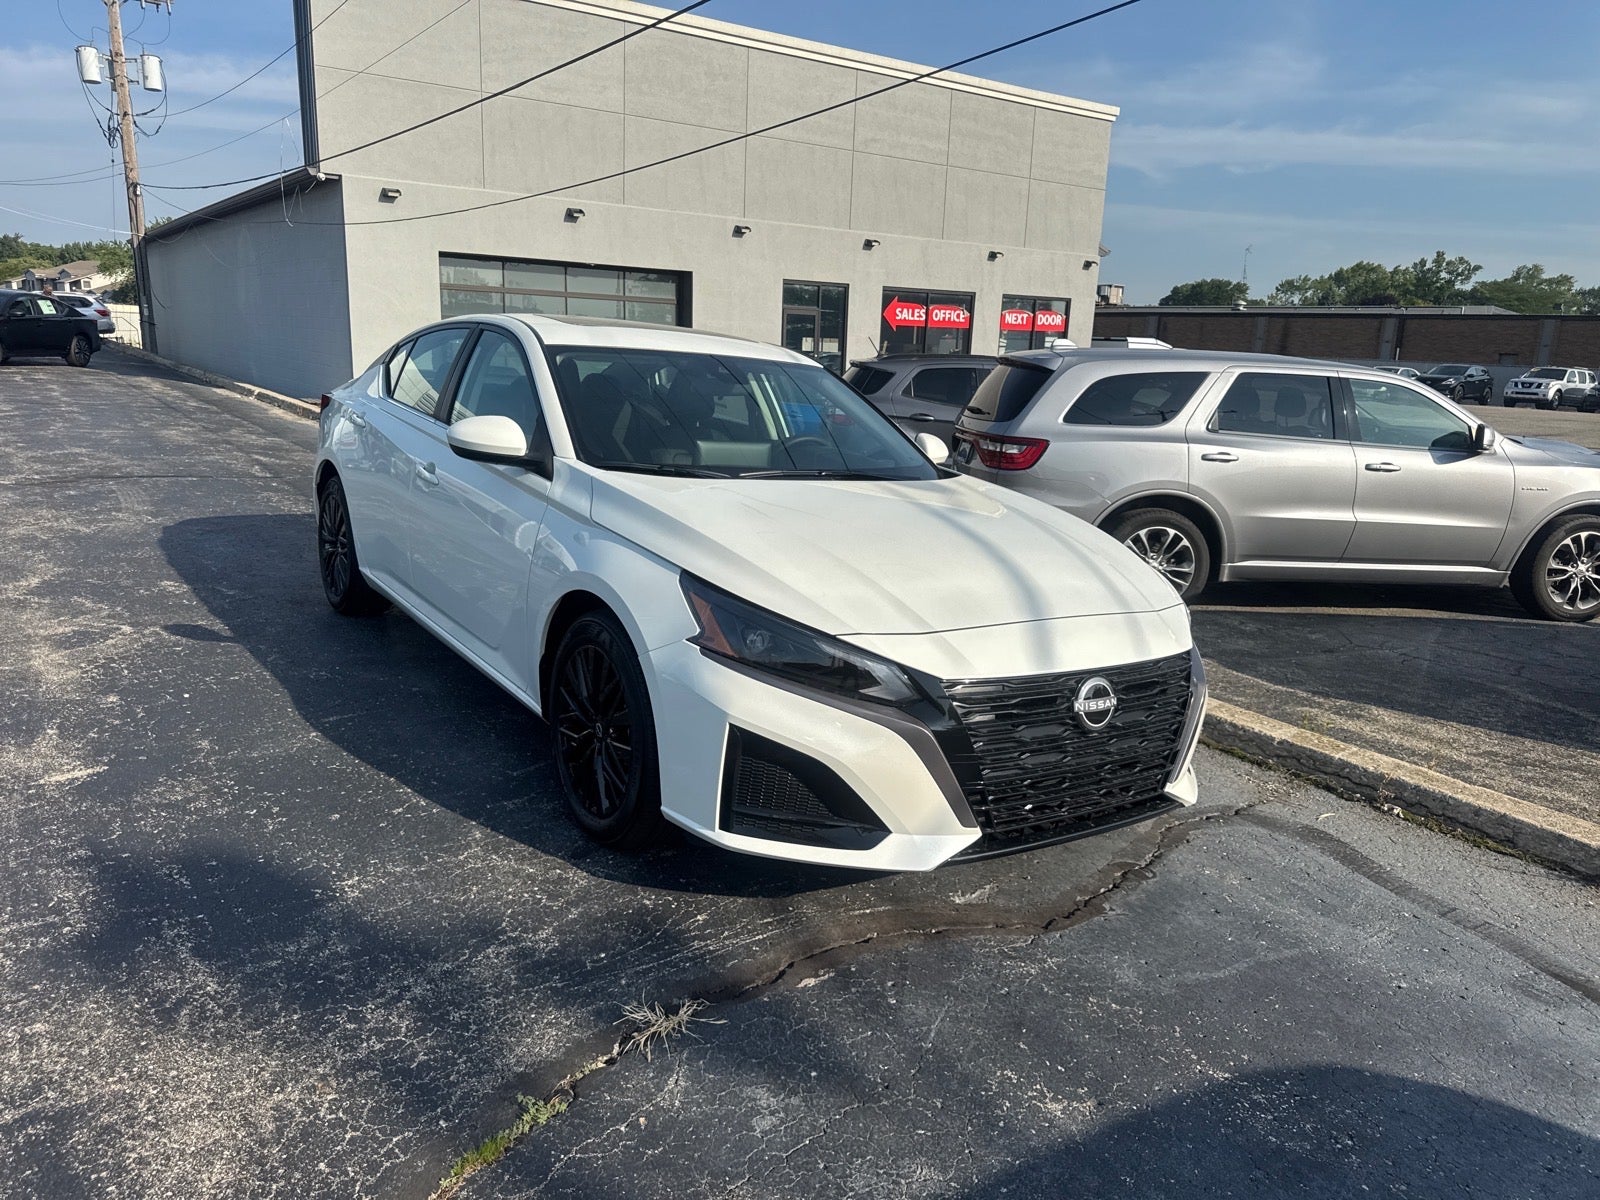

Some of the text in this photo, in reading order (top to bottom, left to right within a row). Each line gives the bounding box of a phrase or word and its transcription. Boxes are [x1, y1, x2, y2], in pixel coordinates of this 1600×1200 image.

[895, 307, 965, 322] SALES OFFICE
[1005, 312, 1062, 326] NEXT DOOR
[1075, 697, 1117, 711] NISSAN
